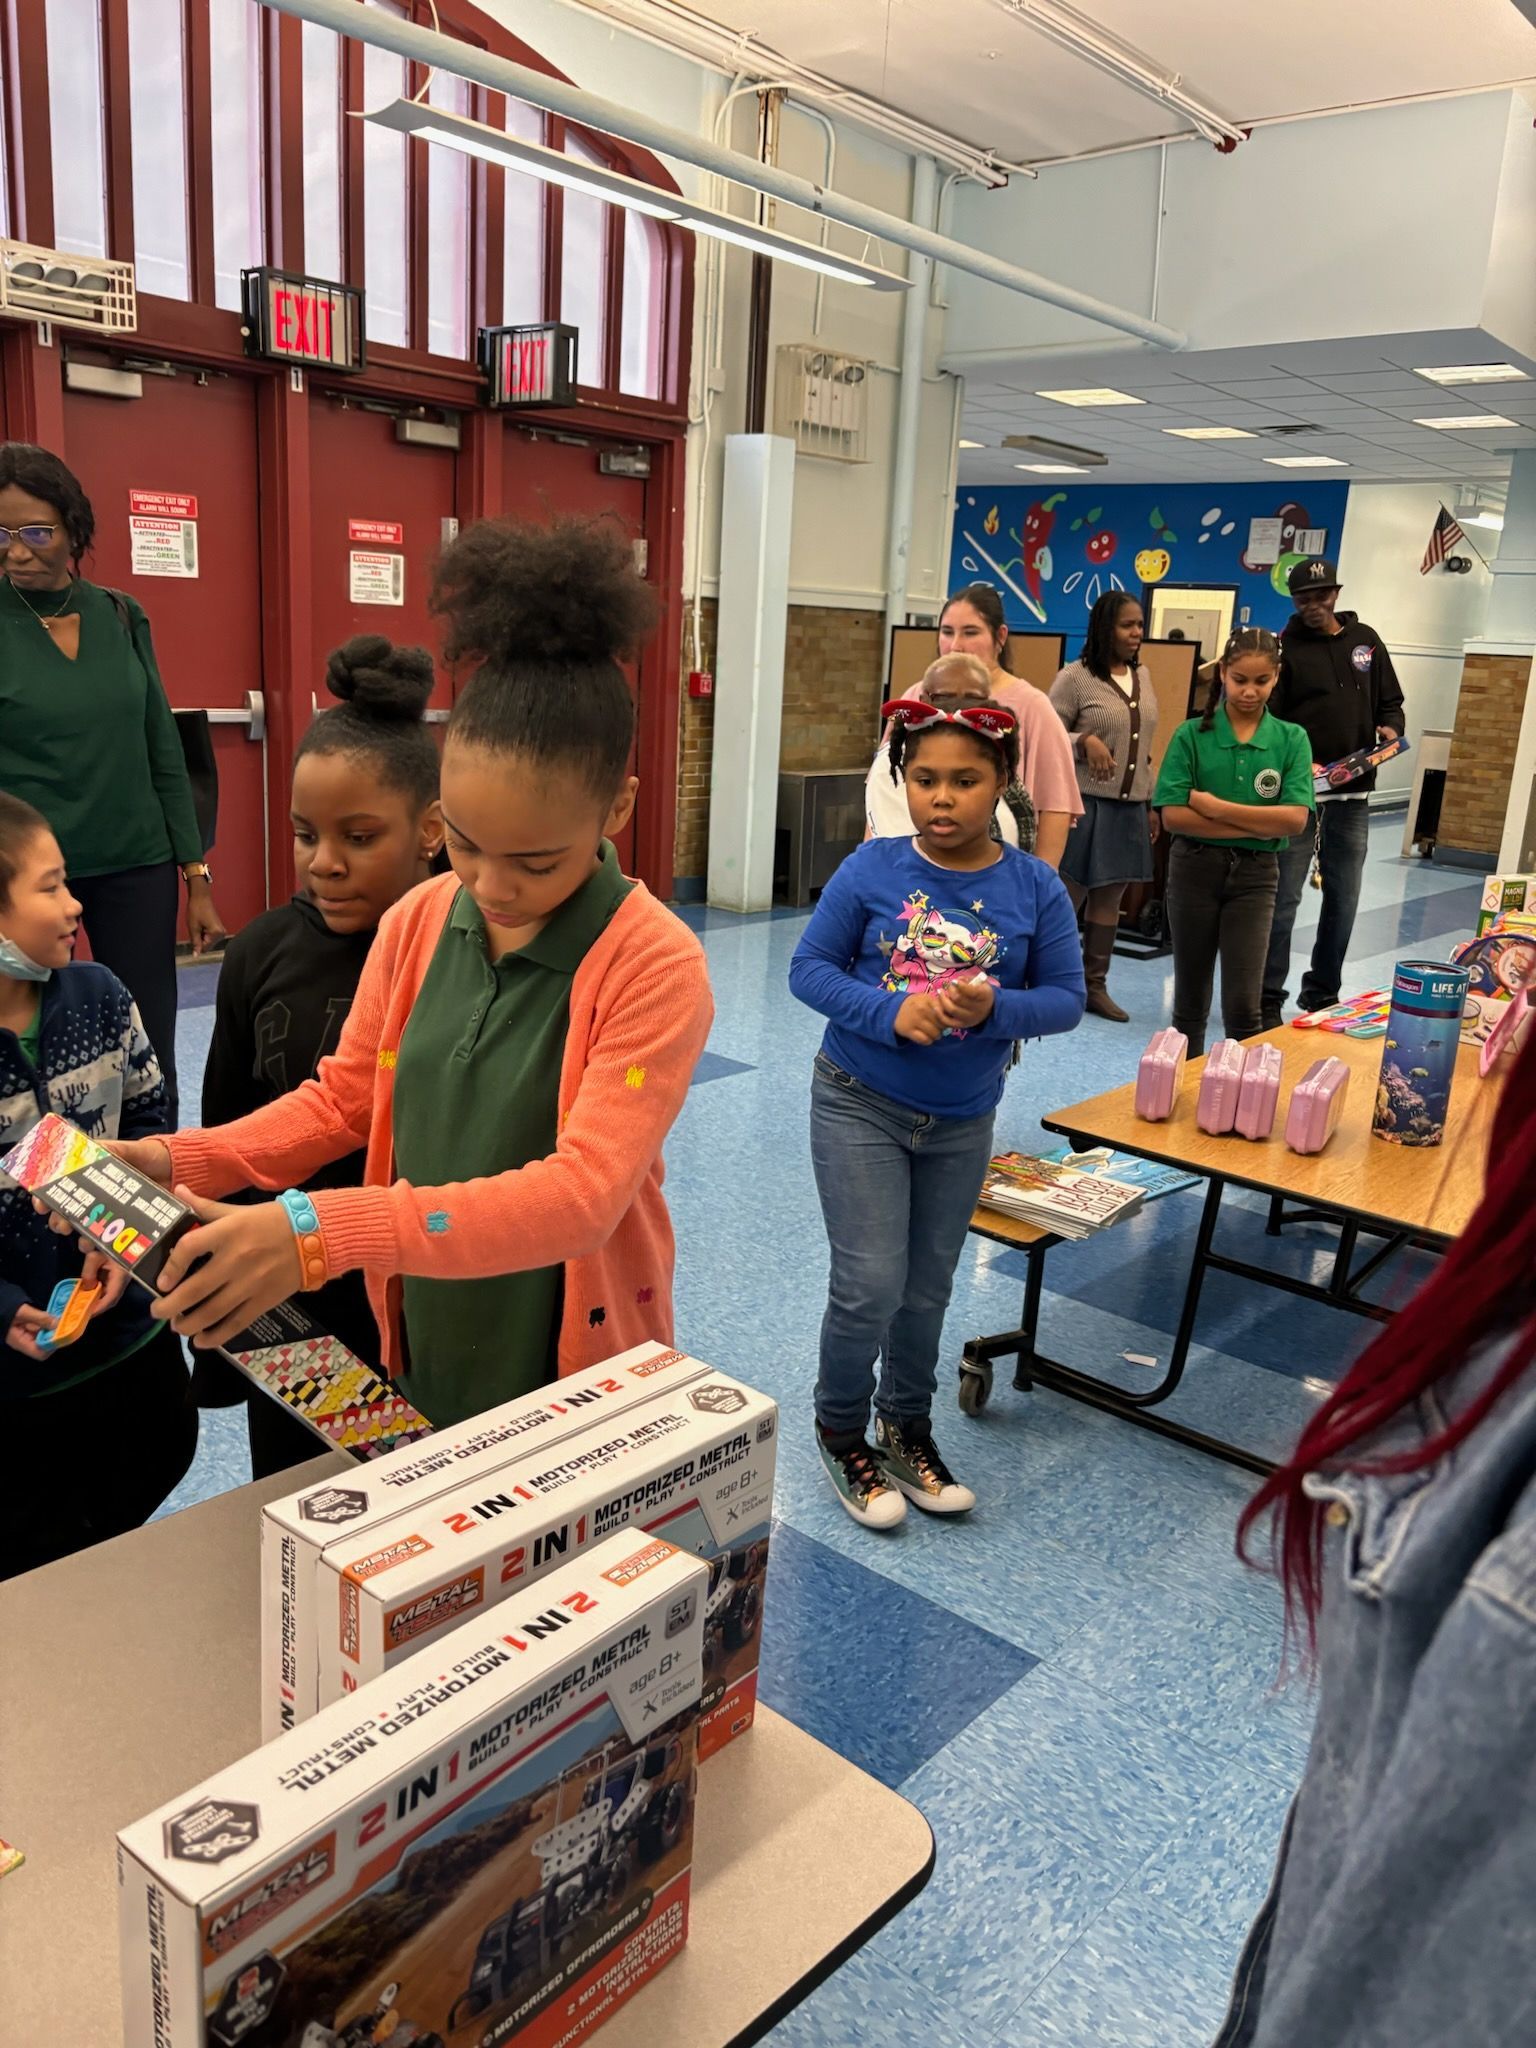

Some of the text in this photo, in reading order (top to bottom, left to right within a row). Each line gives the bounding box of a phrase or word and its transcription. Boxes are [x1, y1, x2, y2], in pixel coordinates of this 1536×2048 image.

[41, 321, 48, 343] 1
[275, 290, 336, 357] EXIT
[293, 369, 299, 389] 1
[505, 339, 550, 393] EXIT
[135, 520, 179, 529] ATTENTION
[156, 537, 170, 545] RED
[156, 552, 180, 560] GREEN
[1432, 982, 1466, 994] LIFE AT
[1048, 1190, 1092, 1210] PEN
[1073, 1177, 1114, 1195] RED
[1080, 1196, 1122, 1218] LITTLE
[1106, 1186, 1138, 1200] THE
[82, 1203, 138, 1254] DOTS
[550, 1378, 624, 1415] 2 IN 1
[380, 1409, 544, 1483] BUILD PLAY CONSTRUCT
[386, 1413, 555, 1487] MOTORIZED METAL
[528, 1414, 684, 1488] MOTORIZED METAL
[540, 1418, 691, 1494] BUILD PLAY CONSTRUCT
[594, 1432, 751, 1524] MOTORIZED METAL
[594, 1447, 751, 1537] BUILD PLAY CONSTRUCT
[716, 1468, 758, 1500] age 8+
[442, 1486, 534, 1534] 2 IN 1
[282, 1535, 290, 1588] METAL
[501, 1514, 586, 1584] 2 IN 1
[391, 1577, 479, 1629] METAL
[503, 1591, 600, 1652] 2 IN 1
[669, 1612, 690, 1632] EM
[671, 1597, 690, 1618] ST
[282, 1591, 290, 1684] MOTORIZED
[281, 1687, 294, 1700] 1
[470, 1623, 651, 1757] MOTORIZED METAL
[629, 1650, 682, 1694] age 8+
[278, 1645, 497, 1784] BUILD PLAY CONSTRUCT
[286, 1651, 512, 1792] MOTORIZED METAL
[468, 1638, 650, 1771] BUILD PLAY CONSTRUCT
[714, 1696, 740, 1718] PARTS
[358, 1752, 460, 1848] 2 IN 1
[624, 1900, 684, 1954] CONTENTS:
[146, 1883, 164, 2048] OTORIZED METAL
[494, 1908, 640, 2038] MOTORIZED OFFROADERS
[578, 1944, 642, 2006] MOTORIZED
[644, 1910, 682, 1946] BUILDS
[606, 1922, 682, 1992] INSTRUCTIONS
[617, 1965, 649, 1996] METAL
[651, 1934, 682, 1965] PARTS
[162, 1984, 170, 2022] PLAY
